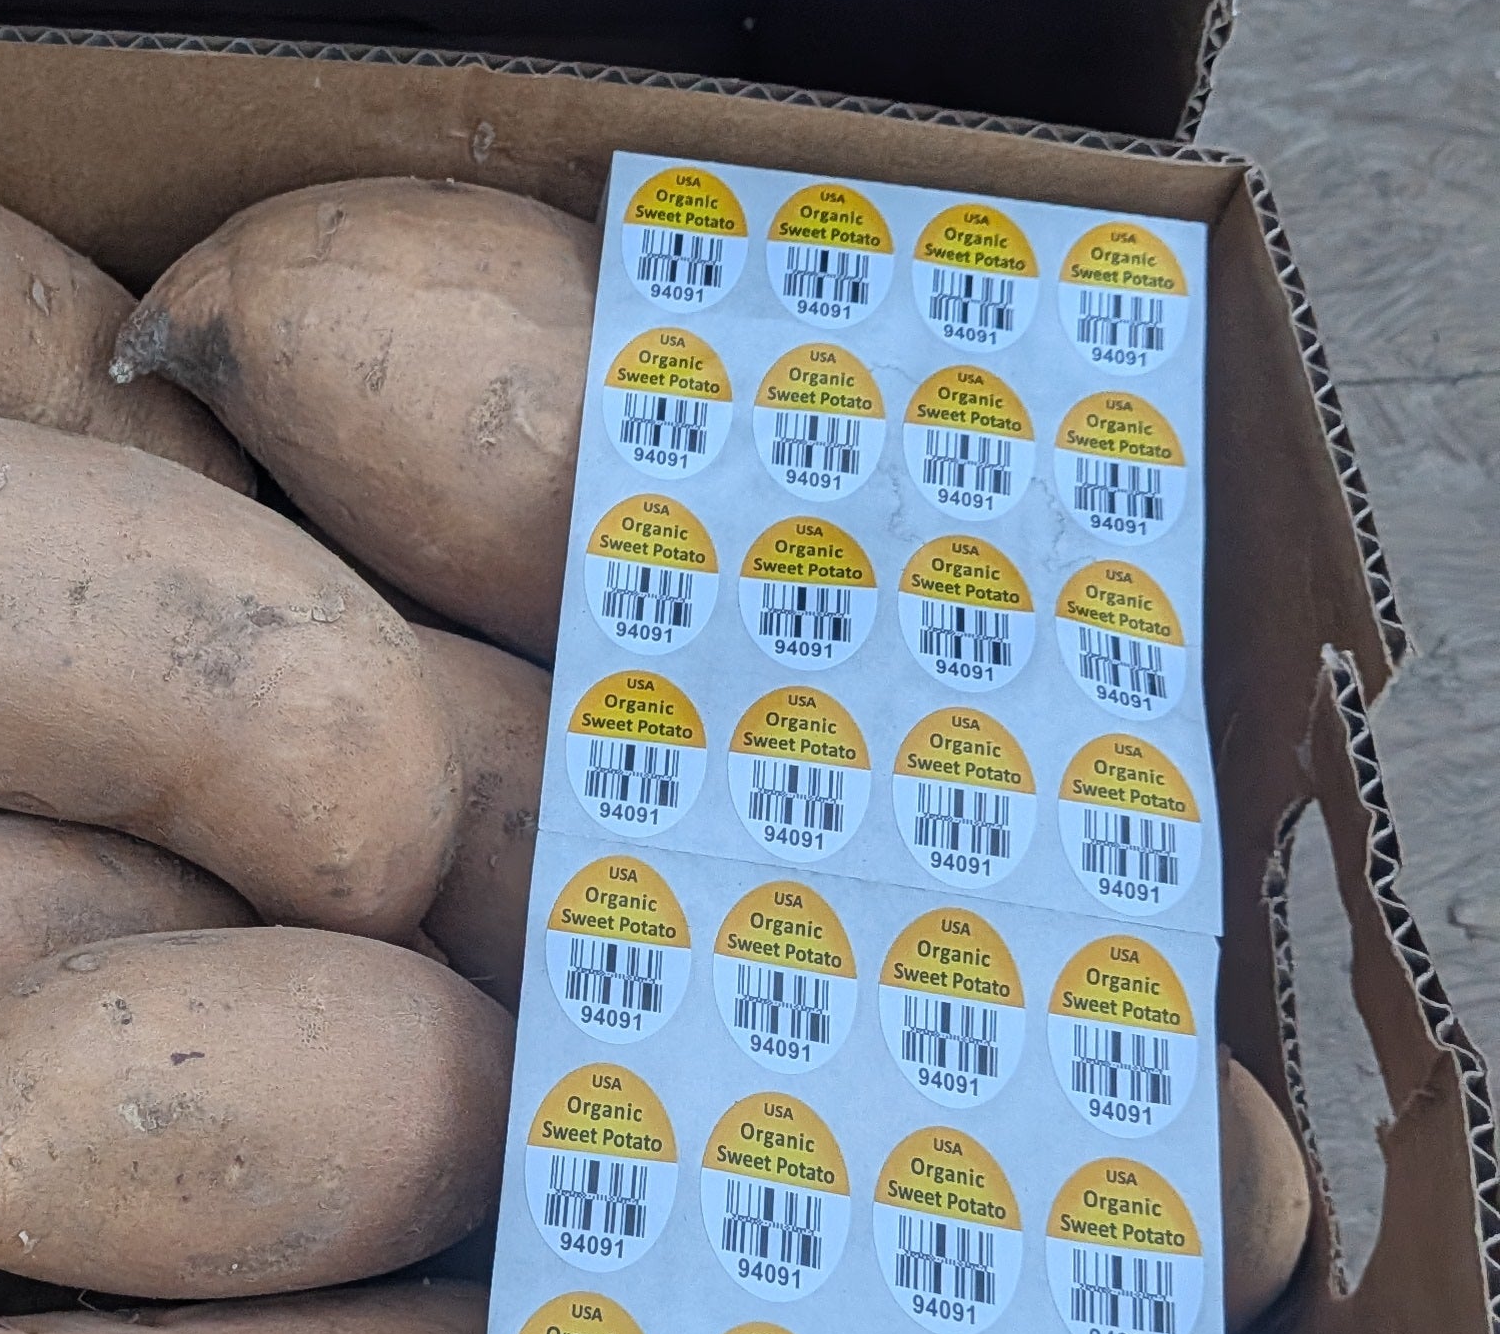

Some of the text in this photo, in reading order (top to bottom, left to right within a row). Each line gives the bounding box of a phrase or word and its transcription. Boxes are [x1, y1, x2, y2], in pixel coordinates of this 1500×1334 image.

[677, 172, 701, 186] USA
[655, 188, 719, 209] Organic
[821, 189, 846, 203] USA
[634, 205, 735, 230] Sweet Potato
[799, 205, 864, 226] Organic
[779, 222, 881, 247] Sweet Potato
[650, 281, 703, 302] 94091
[797, 298, 850, 319] 94091
[660, 333, 686, 347] USA
[638, 350, 704, 371] Organic
[810, 349, 836, 363] USA
[616, 367, 720, 393] Sweet Potato
[788, 367, 855, 388] Organic
[766, 386, 872, 410] Sweet Potato
[937, 385, 1004, 408] Organic
[916, 403, 1022, 432] Sweet Potato
[633, 447, 687, 468] 94091
[785, 469, 841, 490] 94091
[644, 499, 670, 515] USA
[938, 487, 993, 510] 94091
[621, 516, 689, 540] Organic
[796, 521, 824, 535] USA
[598, 535, 706, 564] Sweet Potato
[774, 539, 844, 558] Organic
[951, 540, 979, 556] USA
[752, 558, 863, 580] Sweet Potato
[931, 557, 1000, 581] Organic
[910, 575, 1020, 604] Sweet Potato
[1085, 583, 1151, 612] Organic
[1067, 600, 1171, 637] Sweet Potato
[615, 620, 672, 644] 94091
[774, 638, 832, 658] 94091
[627, 674, 655, 689] USA
[935, 658, 992, 682] 94091
[604, 692, 675, 715] Organic
[788, 690, 817, 707] USA
[1096, 685, 1150, 713] 94091
[580, 713, 693, 739] Sweet Potato
[765, 710, 837, 735] Organic
[952, 711, 981, 729] USA
[742, 731, 856, 760] Sweet Potato
[929, 732, 1002, 758] Organic
[1115, 738, 1144, 756] USA
[906, 753, 1022, 785] Sweet Potato
[1093, 758, 1166, 786] Organic
[1072, 779, 1187, 813] Sweet Potato
[599, 801, 658, 824] 94091
[763, 824, 823, 849] 94091
[609, 865, 637, 883] USA
[930, 850, 990, 876] 94091
[584, 886, 658, 912] Organic
[773, 890, 802, 909] USA
[1099, 876, 1159, 904] 94091
[560, 908, 677, 939] Sweet Potato
[750, 911, 823, 940] Organic
[940, 917, 969, 936] USA
[727, 933, 842, 968] Sweet Potato
[917, 939, 990, 968] Organic
[1108, 945, 1138, 964] USA
[893, 962, 1010, 997] Sweet Potato
[1085, 967, 1160, 996] Organic
[580, 1005, 641, 1031] 94091
[1062, 991, 1182, 1025] Sweet Potato
[749, 1034, 810, 1062] 94091
[592, 1071, 622, 1090] USA
[917, 1067, 978, 1096] 94091
[566, 1095, 643, 1122] Organic
[764, 1098, 794, 1119] USA
[1088, 1097, 1150, 1126] 94091
[541, 1120, 663, 1152] Sweet Potato
[740, 1121, 815, 1153] Organic
[933, 1133, 963, 1154] USA
[715, 1145, 835, 1185] Sweet Potato
[910, 1156, 985, 1189] Organic
[1106, 1164, 1138, 1184] USA
[886, 1180, 1006, 1220] Sweet Potato
[1082, 1188, 1162, 1217] Organic
[1059, 1214, 1185, 1248] Sweet Potato
[559, 1231, 623, 1259] 94091
[737, 1257, 800, 1289] 94091
[572, 1299, 603, 1320] USA
[912, 1293, 974, 1325] 94091
